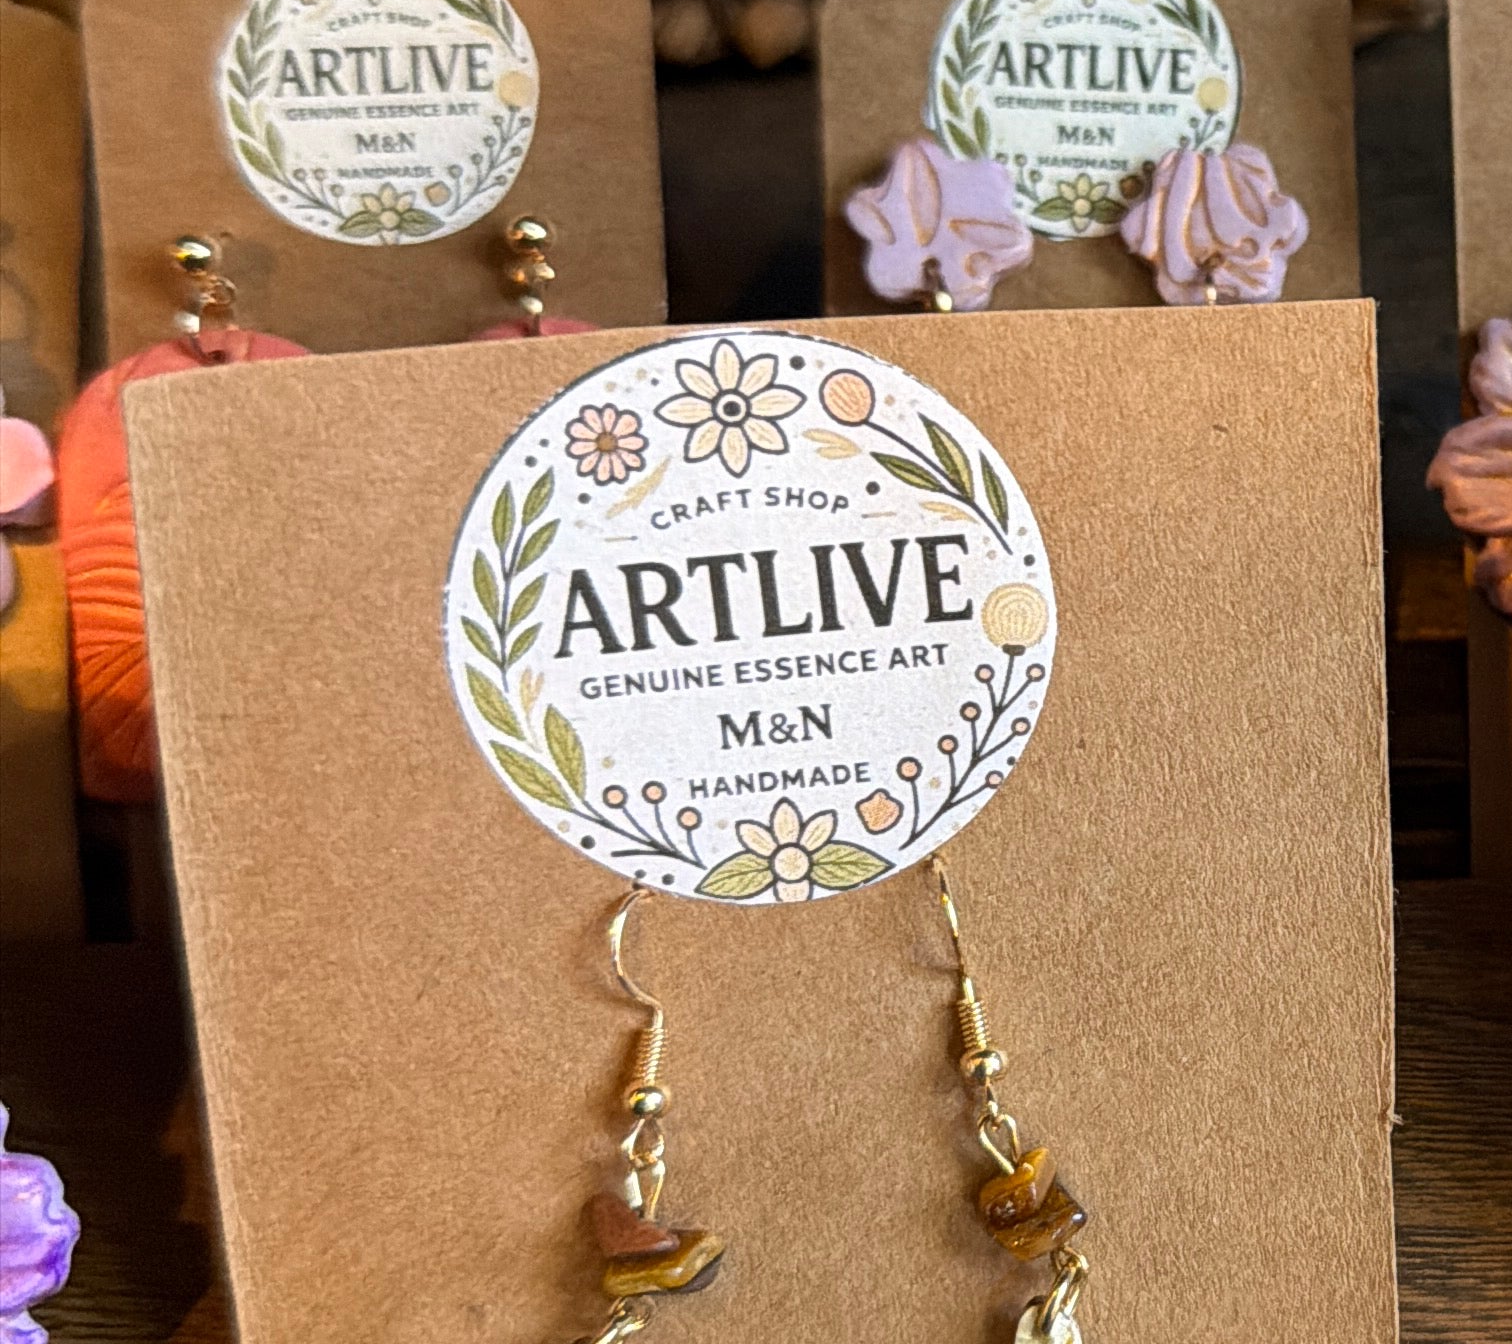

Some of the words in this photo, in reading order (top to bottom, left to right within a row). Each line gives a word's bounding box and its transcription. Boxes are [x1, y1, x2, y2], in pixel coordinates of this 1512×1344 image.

[274, 43, 494, 98] ARTLIVE
[985, 40, 1197, 95] ARTLIVE
[355, 132, 417, 154] M&N
[1056, 125, 1115, 146] M&N
[650, 489, 752, 530] CRAFT
[764, 486, 850, 515] SHOP
[553, 533, 974, 659] ARTLIVE
[580, 664, 724, 700] GENUINE
[735, 650, 878, 685] ESSENCE
[888, 643, 950, 671] ART
[718, 704, 834, 750] M&N
[689, 762, 872, 800] HANDMADE
